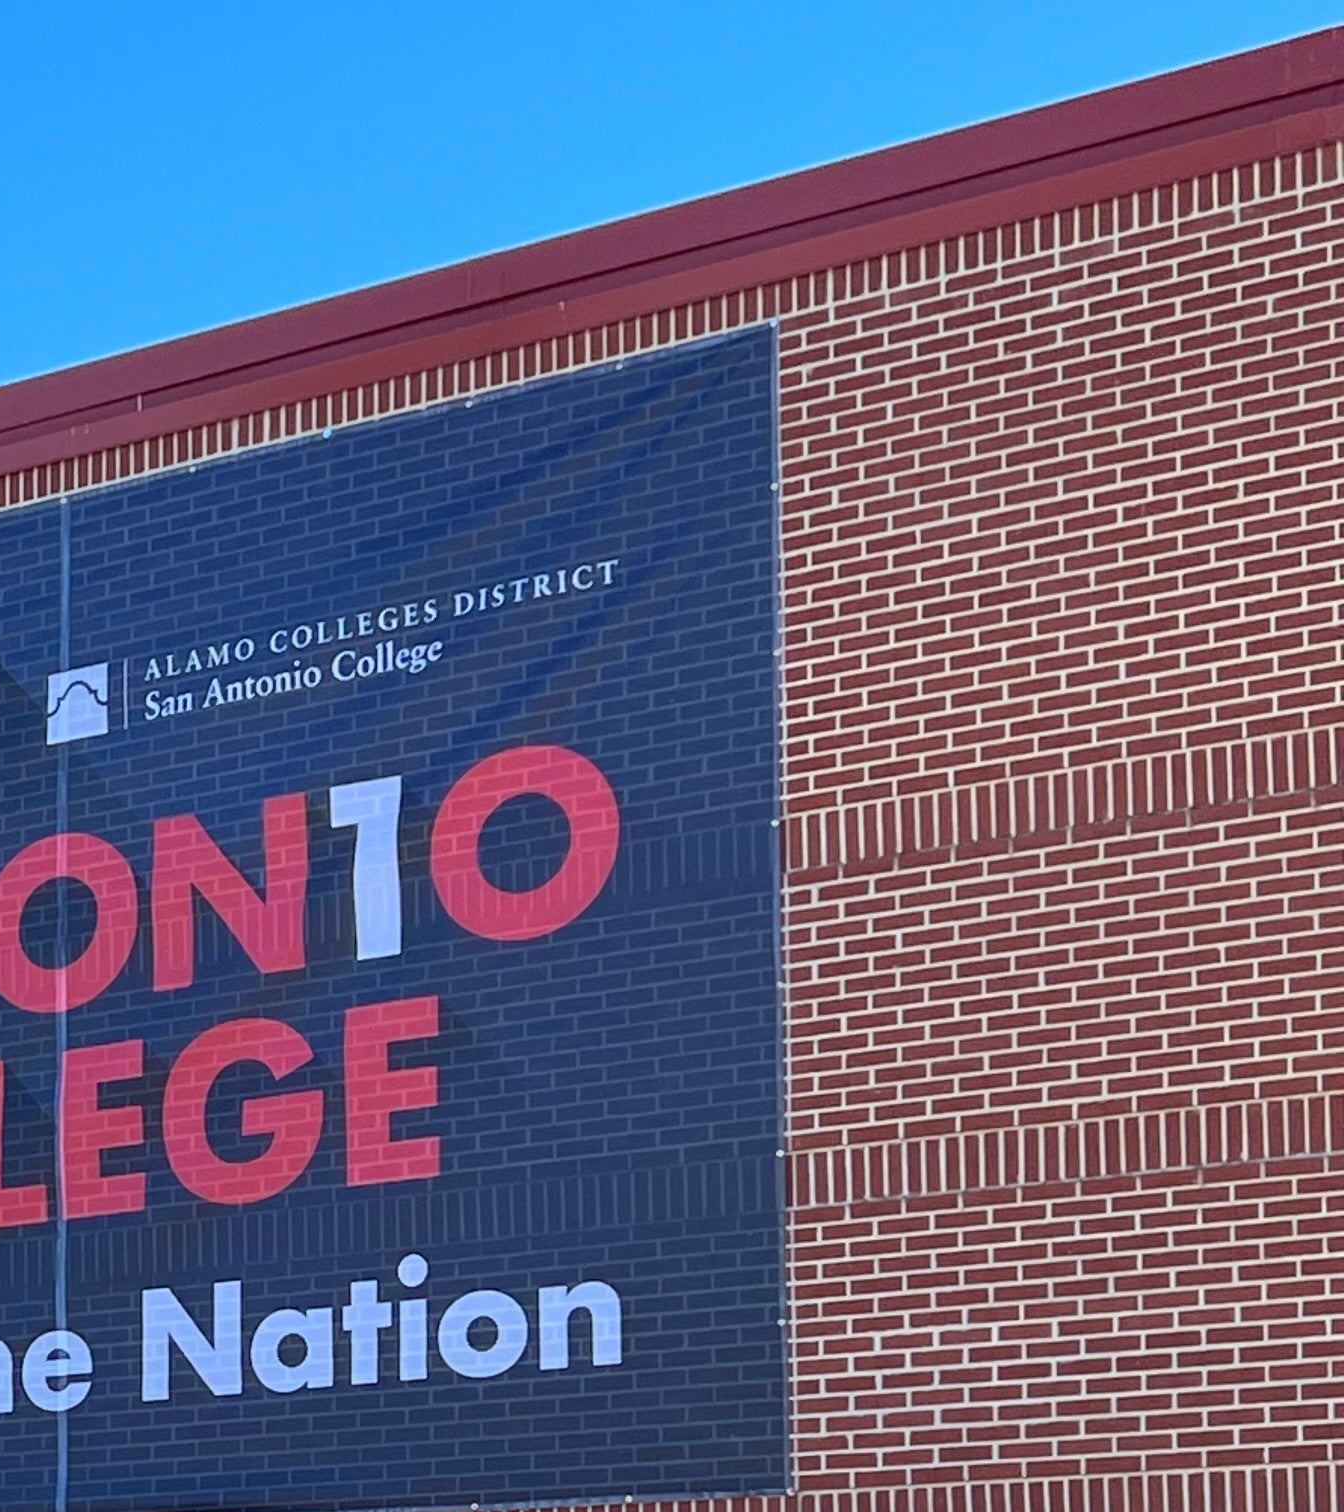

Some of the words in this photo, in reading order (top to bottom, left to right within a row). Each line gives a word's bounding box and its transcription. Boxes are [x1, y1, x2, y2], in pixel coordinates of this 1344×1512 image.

[144, 638, 254, 681] ALAMO
[270, 599, 438, 653] COLLEGES
[454, 559, 620, 616] DISTRICT
[144, 690, 193, 721] San
[203, 660, 322, 708] Antonio
[331, 640, 443, 681] College
[141, 1253, 624, 1403] Nation
